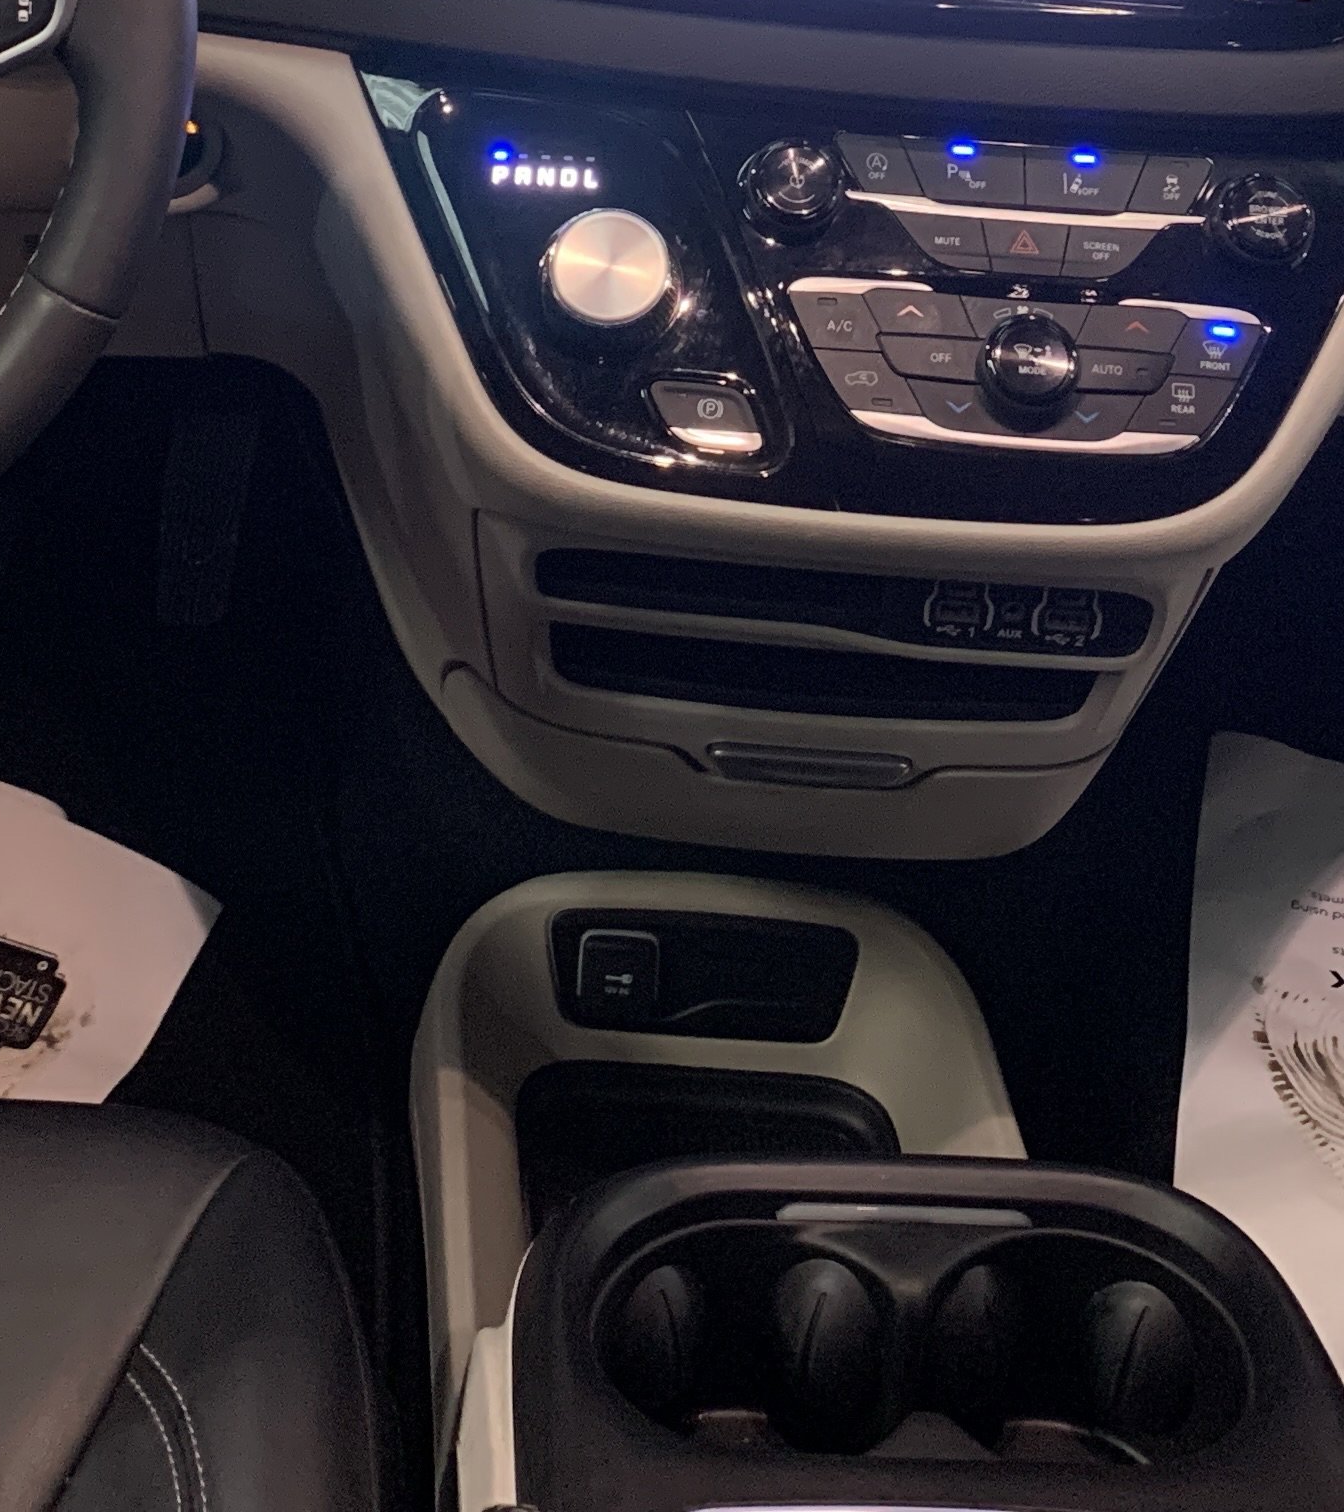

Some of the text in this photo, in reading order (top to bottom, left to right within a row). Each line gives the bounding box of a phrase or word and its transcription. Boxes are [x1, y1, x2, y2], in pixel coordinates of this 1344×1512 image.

[868, 172, 886, 180] OFF
[968, 180, 987, 190] OFF
[1081, 188, 1099, 197] OFF
[1163, 192, 1181, 201] OFF
[934, 235, 961, 246] MUTE
[1083, 240, 1119, 253] SCREEN
[1092, 251, 1110, 261] OFF
[827, 319, 853, 332] A/C
[930, 352, 952, 364] OFF
[1018, 364, 1047, 376] MODE
[1091, 363, 1123, 376] AUTO
[1199, 360, 1231, 372] FRONT
[1170, 404, 1196, 415] REAR
[997, 628, 1022, 638] AUX
[1289, 898, 1327, 915] using
